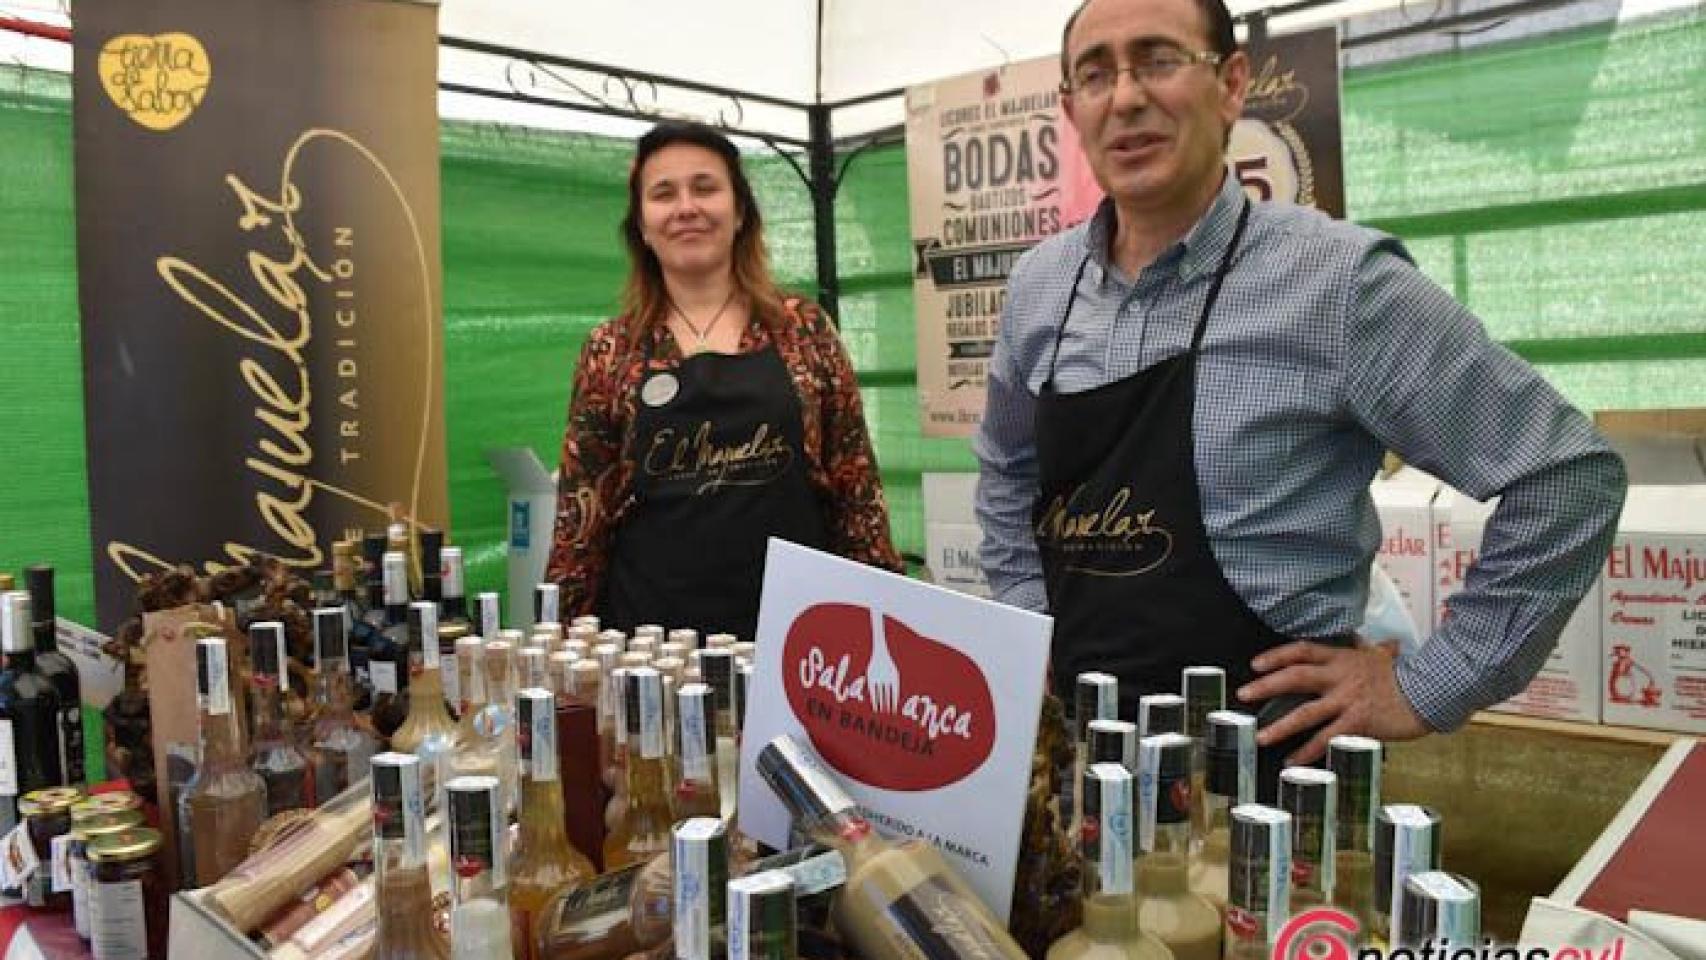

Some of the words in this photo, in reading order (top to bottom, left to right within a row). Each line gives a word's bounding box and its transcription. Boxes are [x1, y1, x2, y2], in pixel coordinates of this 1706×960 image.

[943, 124, 1059, 194] BODAS
[943, 206, 1061, 246] COMUNIONES
[953, 254, 970, 281] EL
[334, 226, 361, 466] TRADICIÓN
[1608, 544, 1632, 578] El
[799, 646, 973, 740] Salamanca
[806, 697, 832, 722] EN
[840, 711, 934, 757] BANDEJA
[945, 839, 990, 868] MARCA
